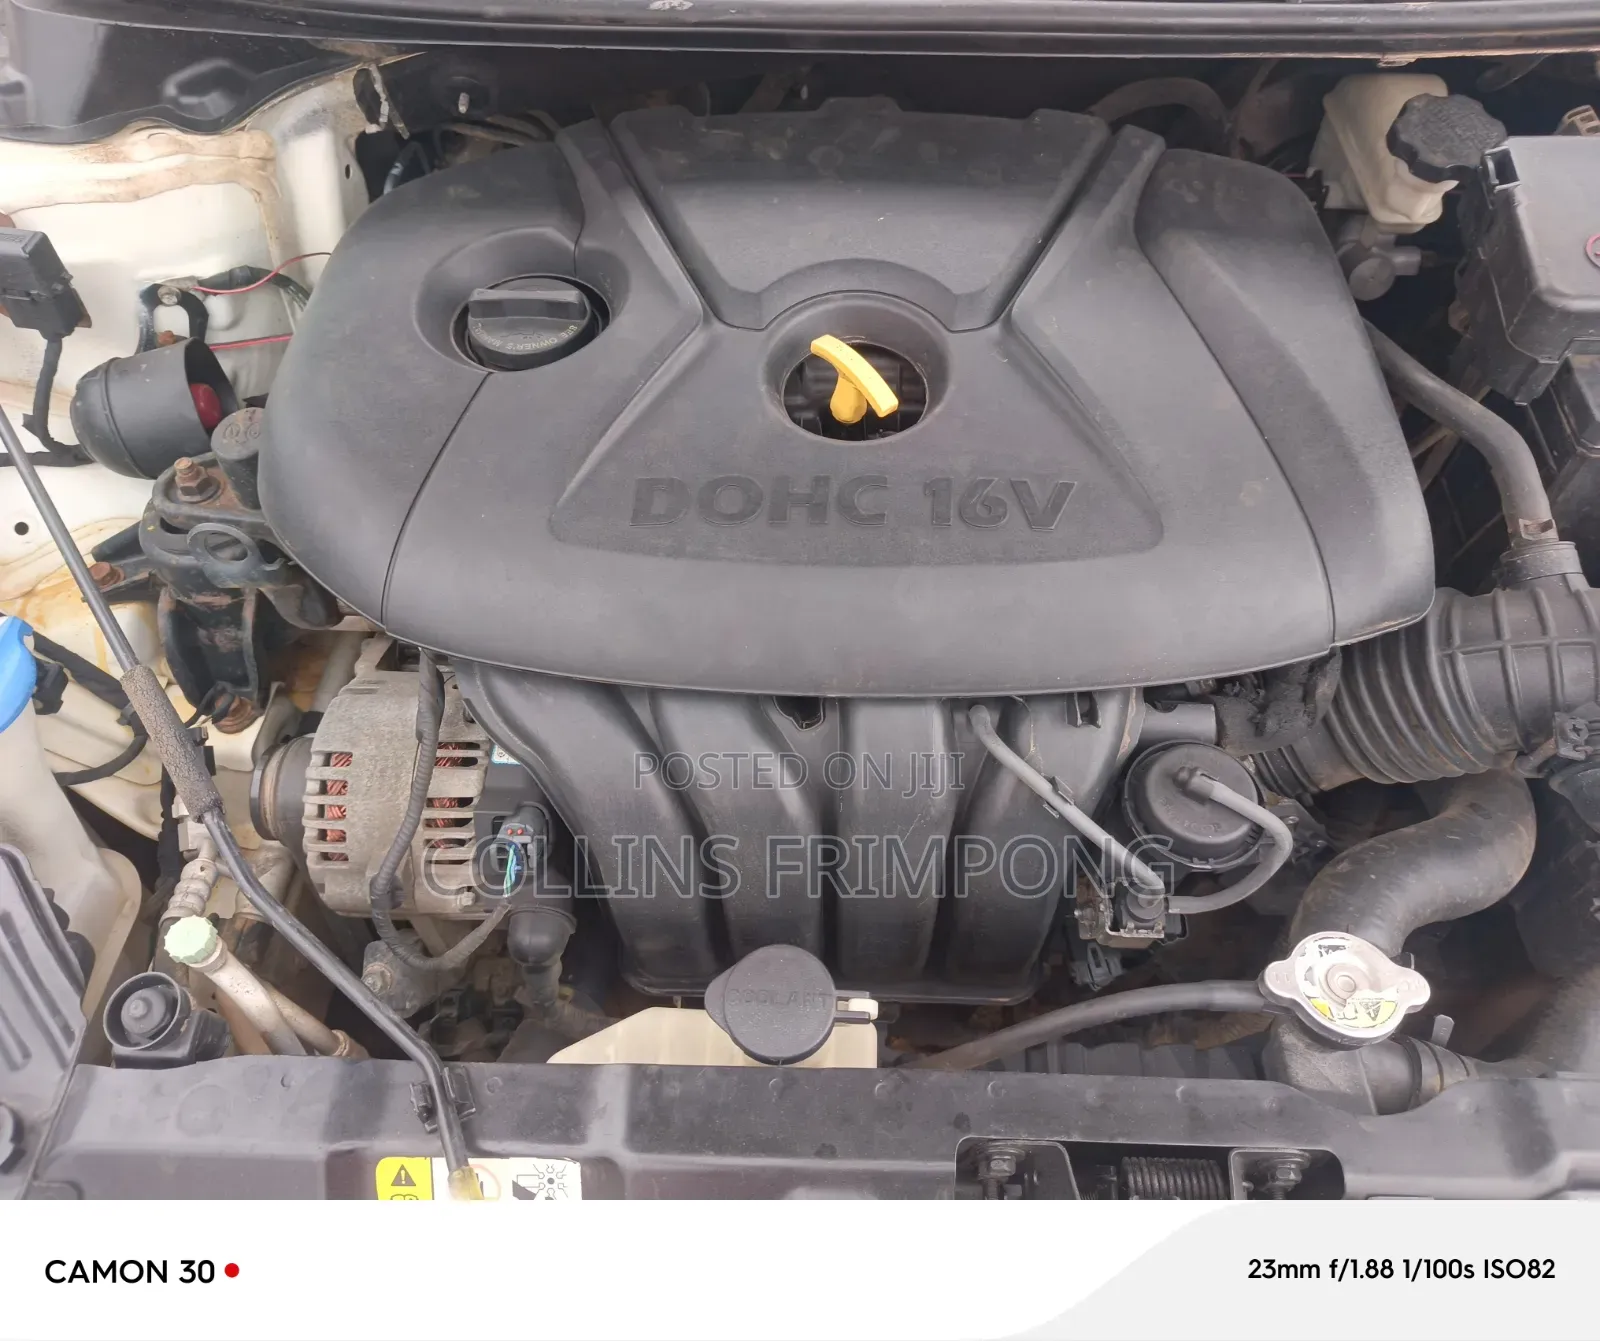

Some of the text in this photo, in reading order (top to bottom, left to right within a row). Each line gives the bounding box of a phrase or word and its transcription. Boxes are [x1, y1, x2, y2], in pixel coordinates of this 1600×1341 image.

[505, 336, 558, 351] OWNER'S
[629, 474, 1078, 531] DOHC 16V
[727, 988, 827, 1009] COOLANT
